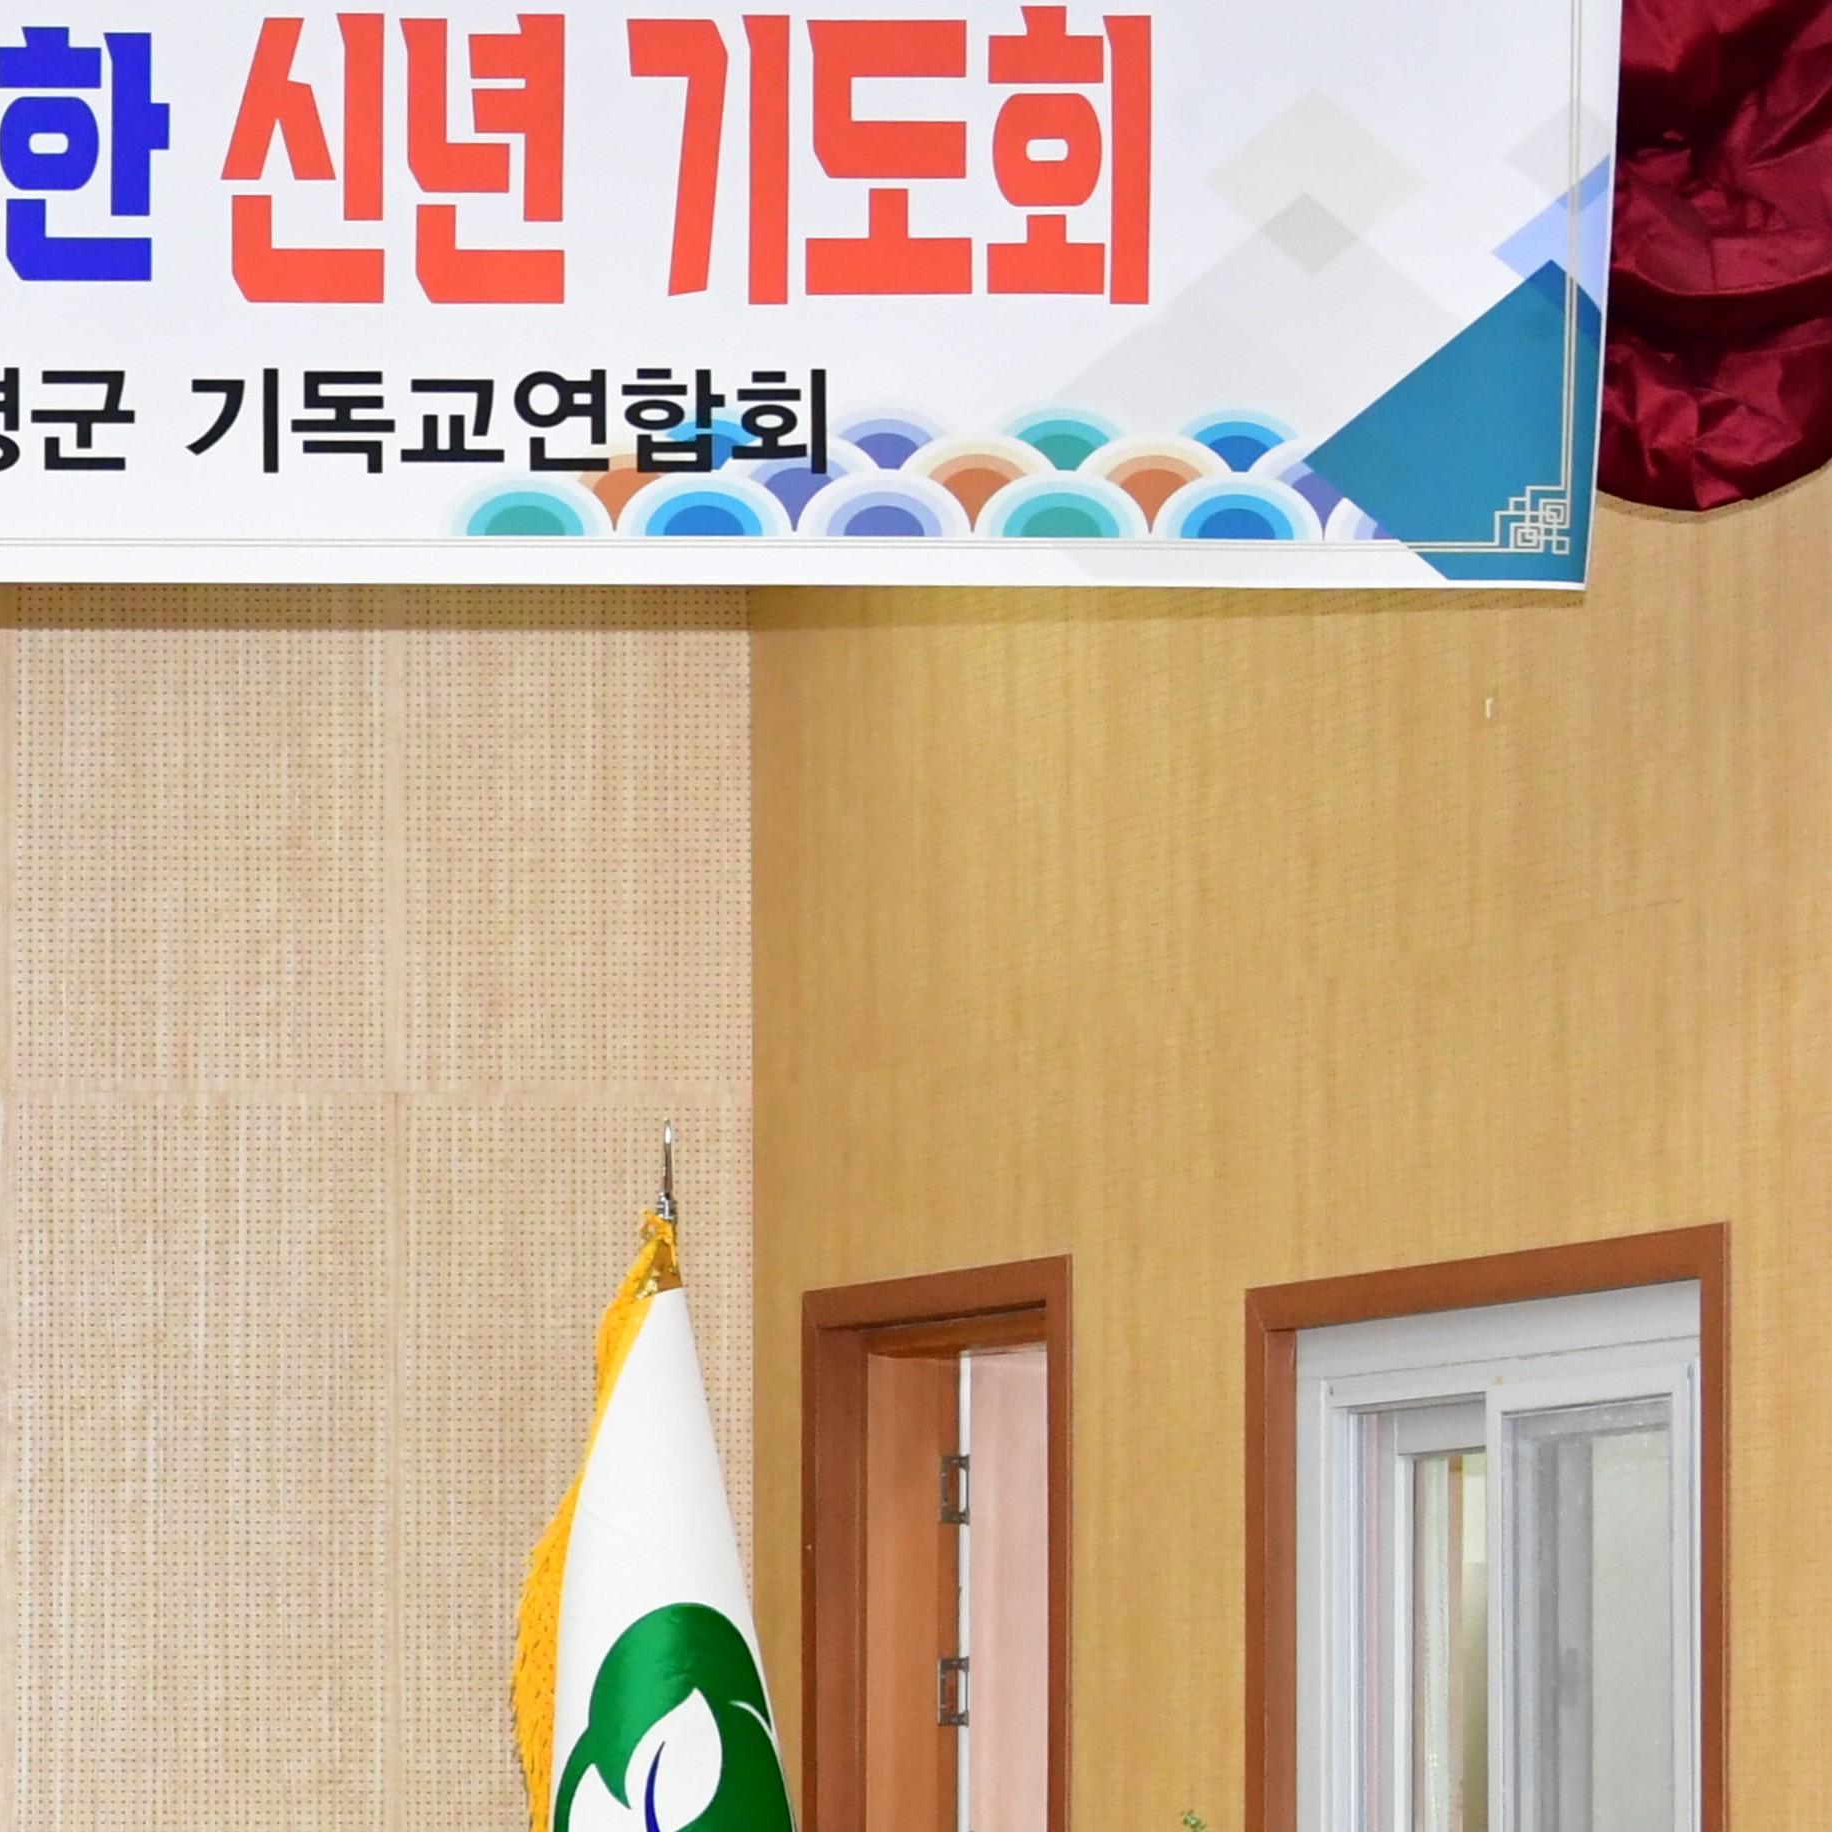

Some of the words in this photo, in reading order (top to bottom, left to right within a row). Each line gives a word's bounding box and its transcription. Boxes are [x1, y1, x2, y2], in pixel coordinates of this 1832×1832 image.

[222, 13, 566, 305] 신년
[627, 5, 1153, 306] 기도회
[187, 368, 828, 476] 기독교연합회
